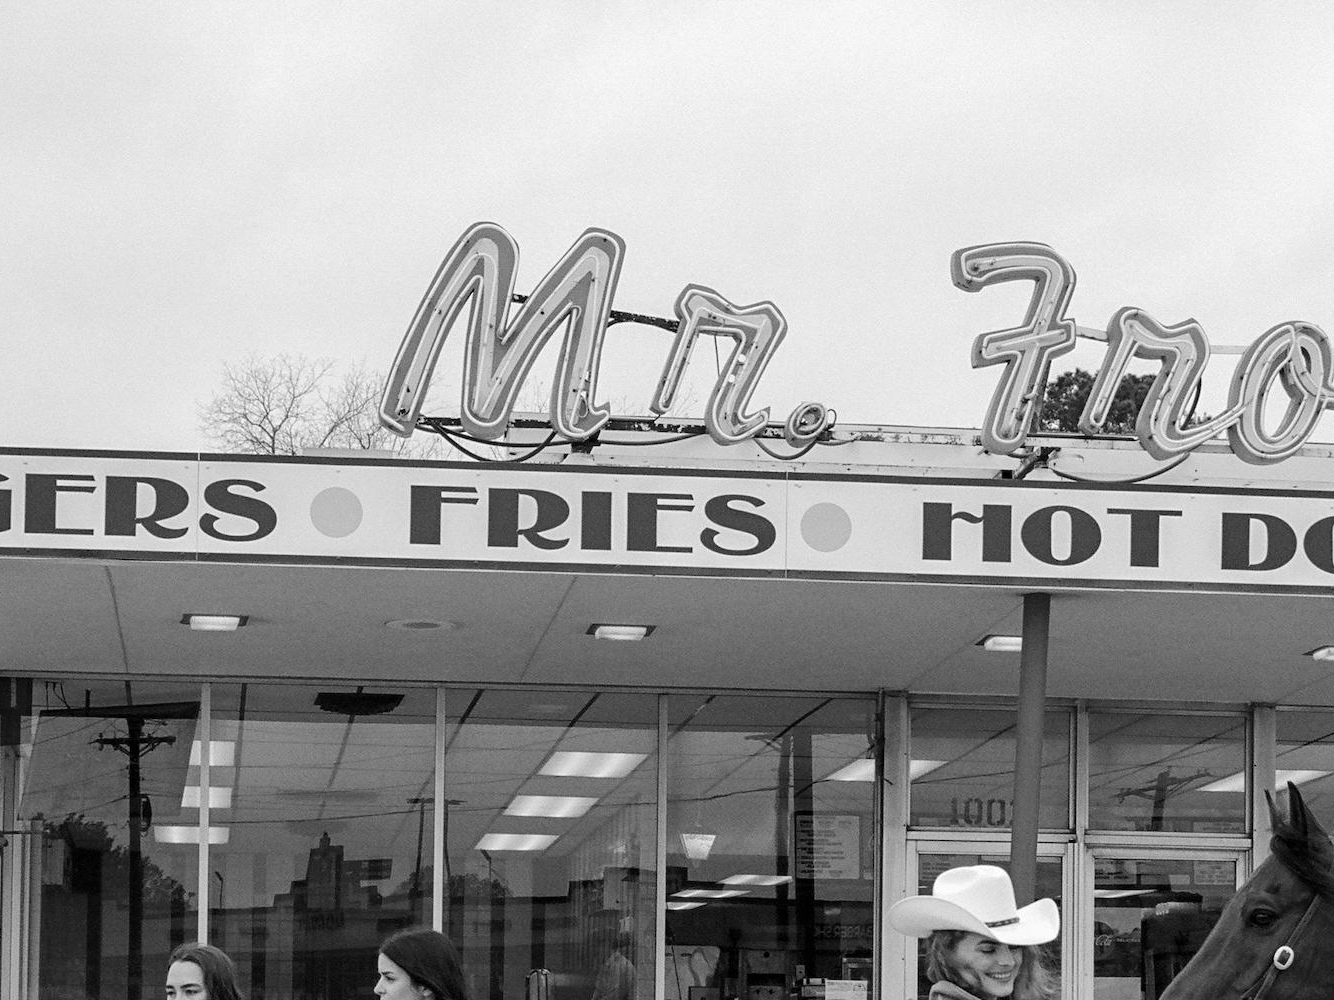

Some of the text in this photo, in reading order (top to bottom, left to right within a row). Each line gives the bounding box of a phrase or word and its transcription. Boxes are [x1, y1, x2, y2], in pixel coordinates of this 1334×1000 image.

[379, 221, 828, 447] Mr.
[410, 485, 777, 556] FRIES
[922, 501, 1183, 568] HOT
[950, 798, 1014, 826] 100
